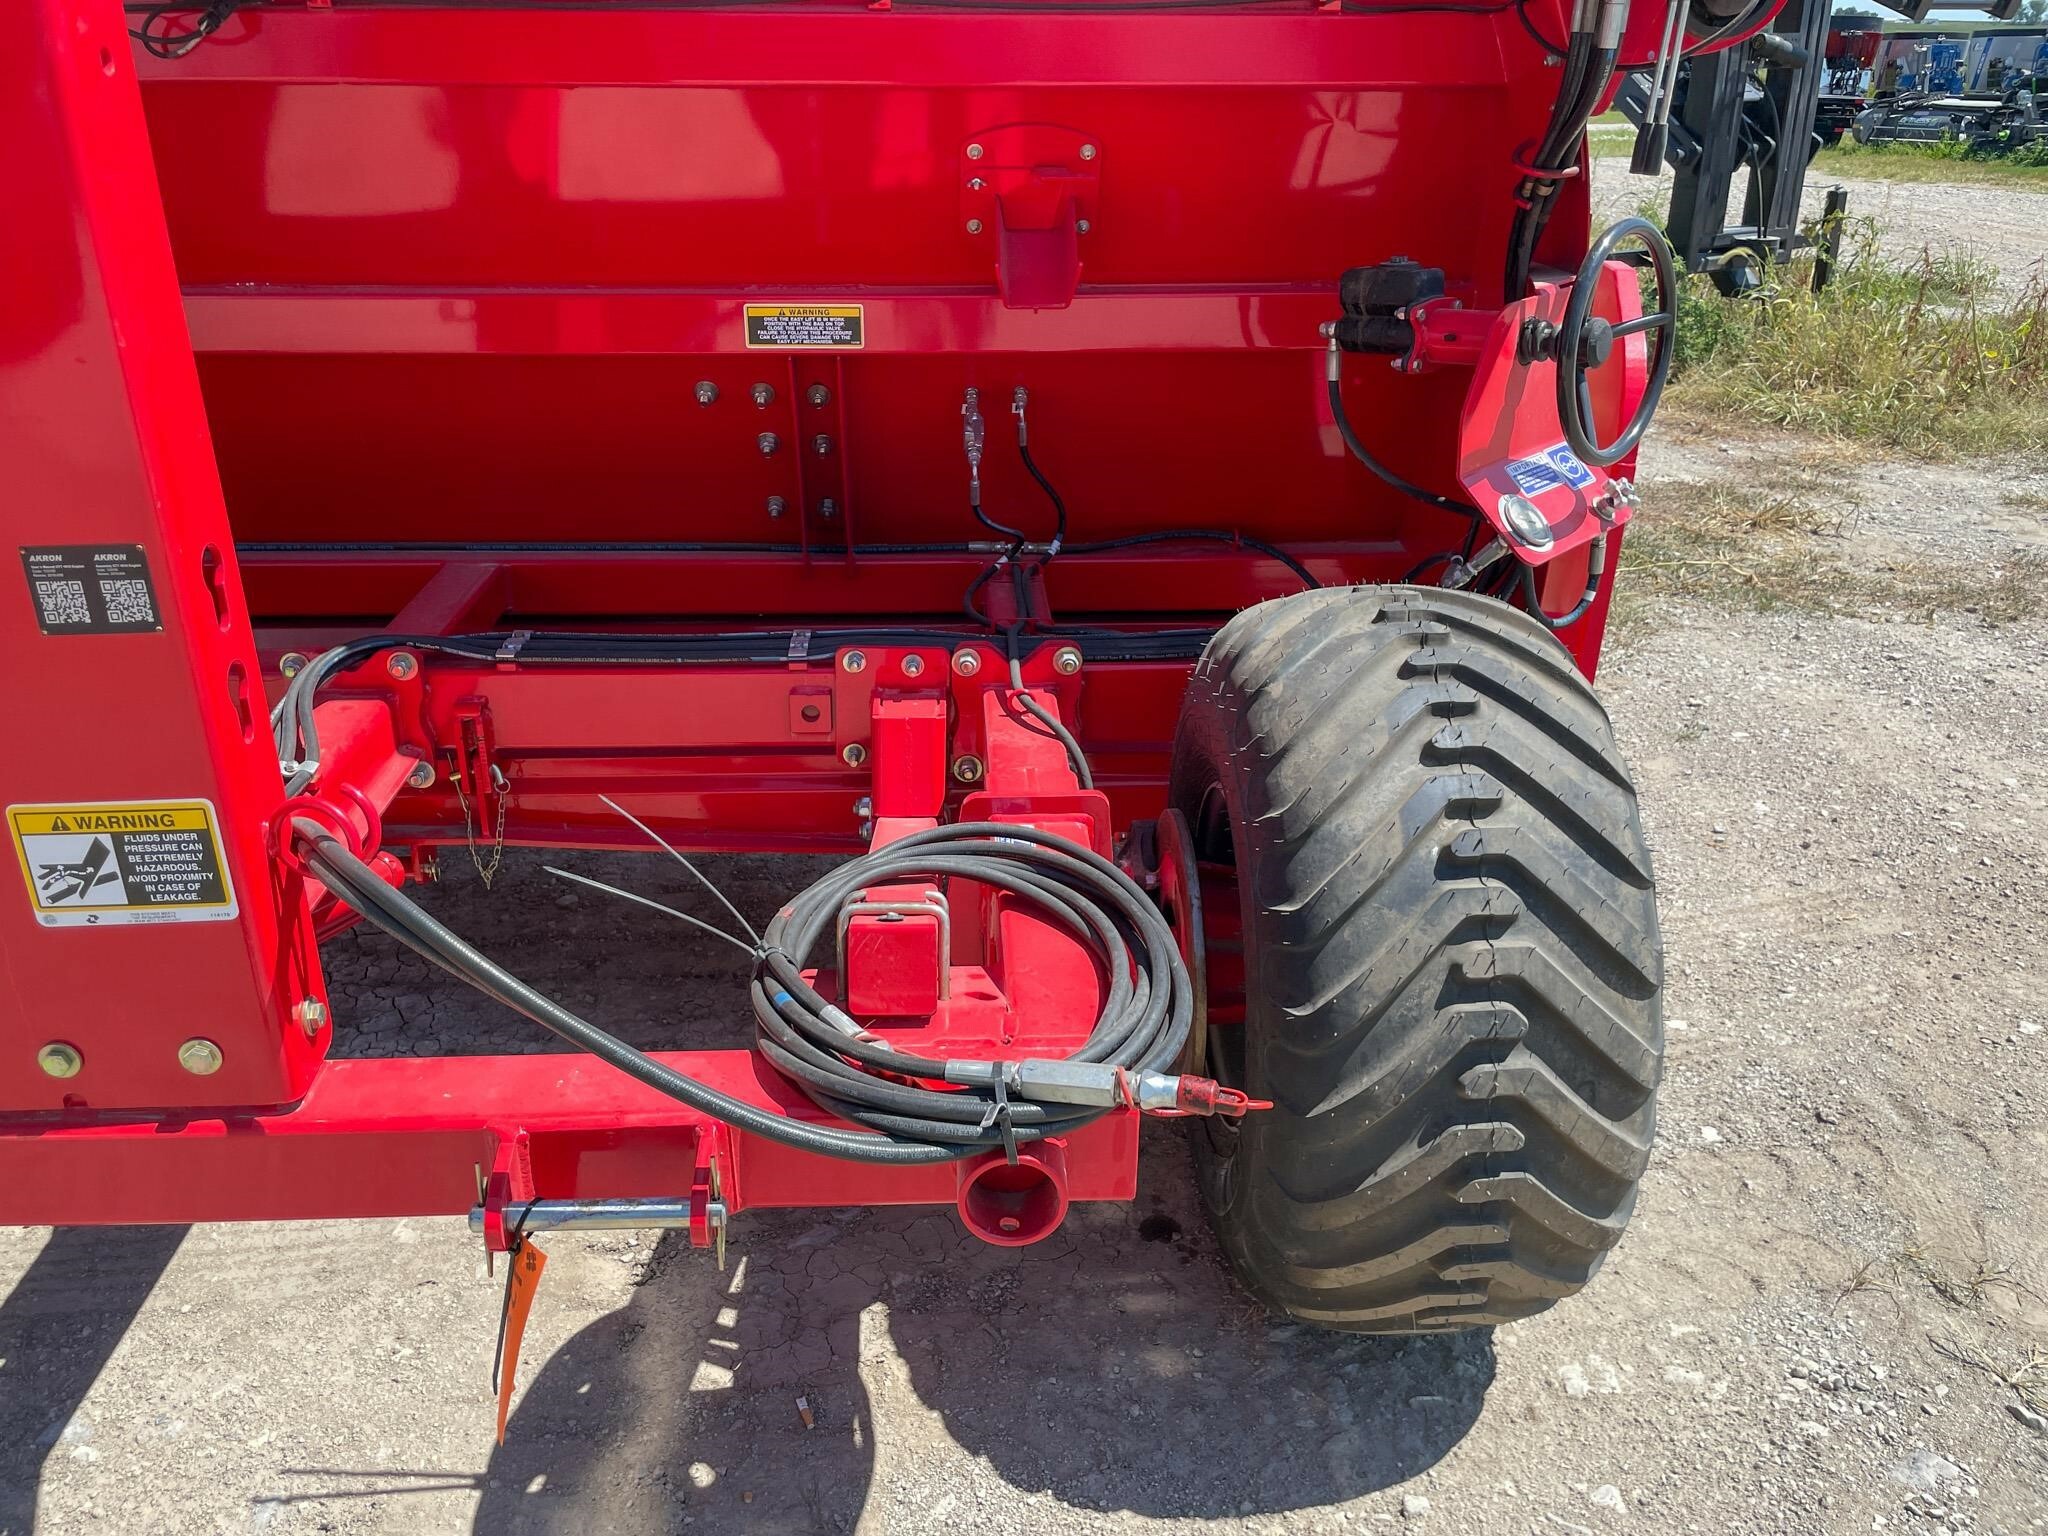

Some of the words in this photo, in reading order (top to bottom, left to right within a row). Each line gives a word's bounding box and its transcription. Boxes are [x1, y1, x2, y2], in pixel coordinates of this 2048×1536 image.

[1510, 456, 1545, 473] IMPORTANT
[72, 814, 176, 830] WARNING
[124, 834, 161, 843] FLUIDS
[162, 833, 198, 842] UNDER
[124, 844, 179, 853] PRESSURE
[181, 842, 203, 851] CAN
[144, 853, 204, 862] EXTREMELY
[135, 863, 202, 872] HAZARDOUS.
[128, 874, 159, 883] AVOID
[160, 872, 214, 882] PROXIMITY
[145, 884, 158, 892] IN
[159, 883, 186, 892] CASE
[187, 883, 201, 891] OF
[150, 892, 202, 902] LEAKAGE.
